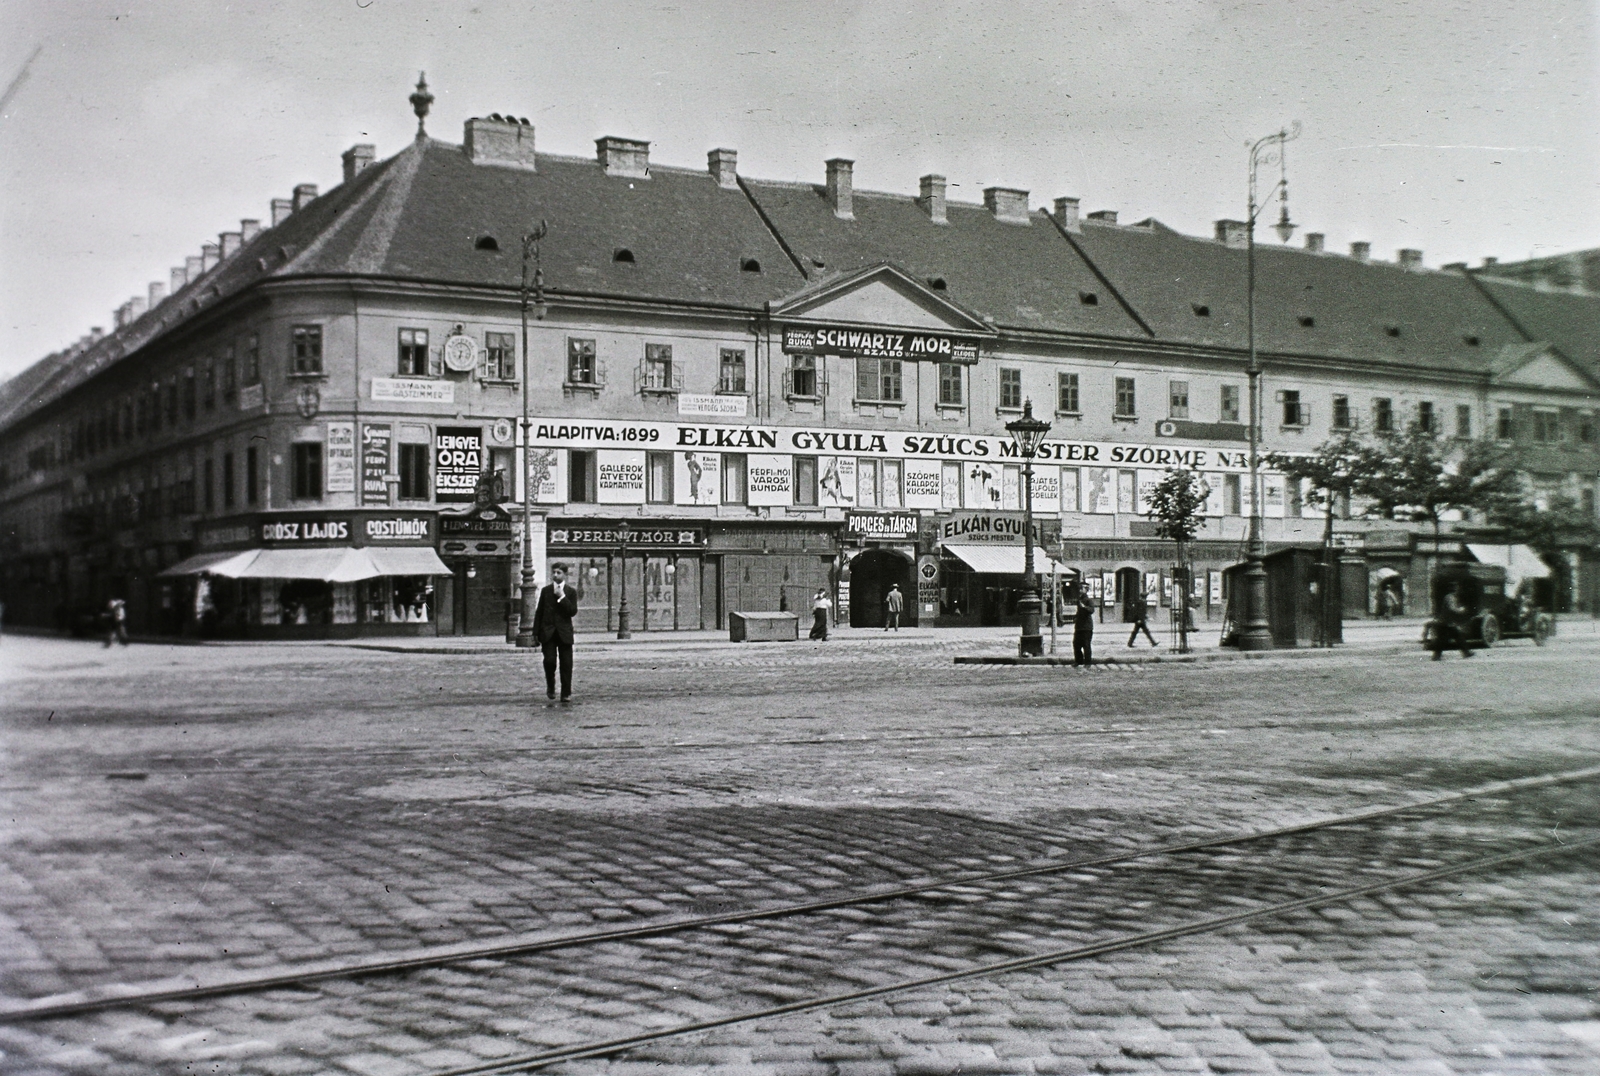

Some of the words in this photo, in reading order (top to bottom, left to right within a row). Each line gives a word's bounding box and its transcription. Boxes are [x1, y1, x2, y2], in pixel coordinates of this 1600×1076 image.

[816, 329, 904, 351] SCHWARTZ
[437, 435, 481, 450] LENGYEL
[676, 426, 779, 448] ELKÁN
[791, 431, 888, 452] GYULA
[998, 440, 1100, 461] MSTER
[303, 521, 348, 539] LAJOS
[889, 514, 918, 533] TÁRSA
[944, 513, 991, 539] ELKÁN
[640, 529, 675, 543] MÓR
